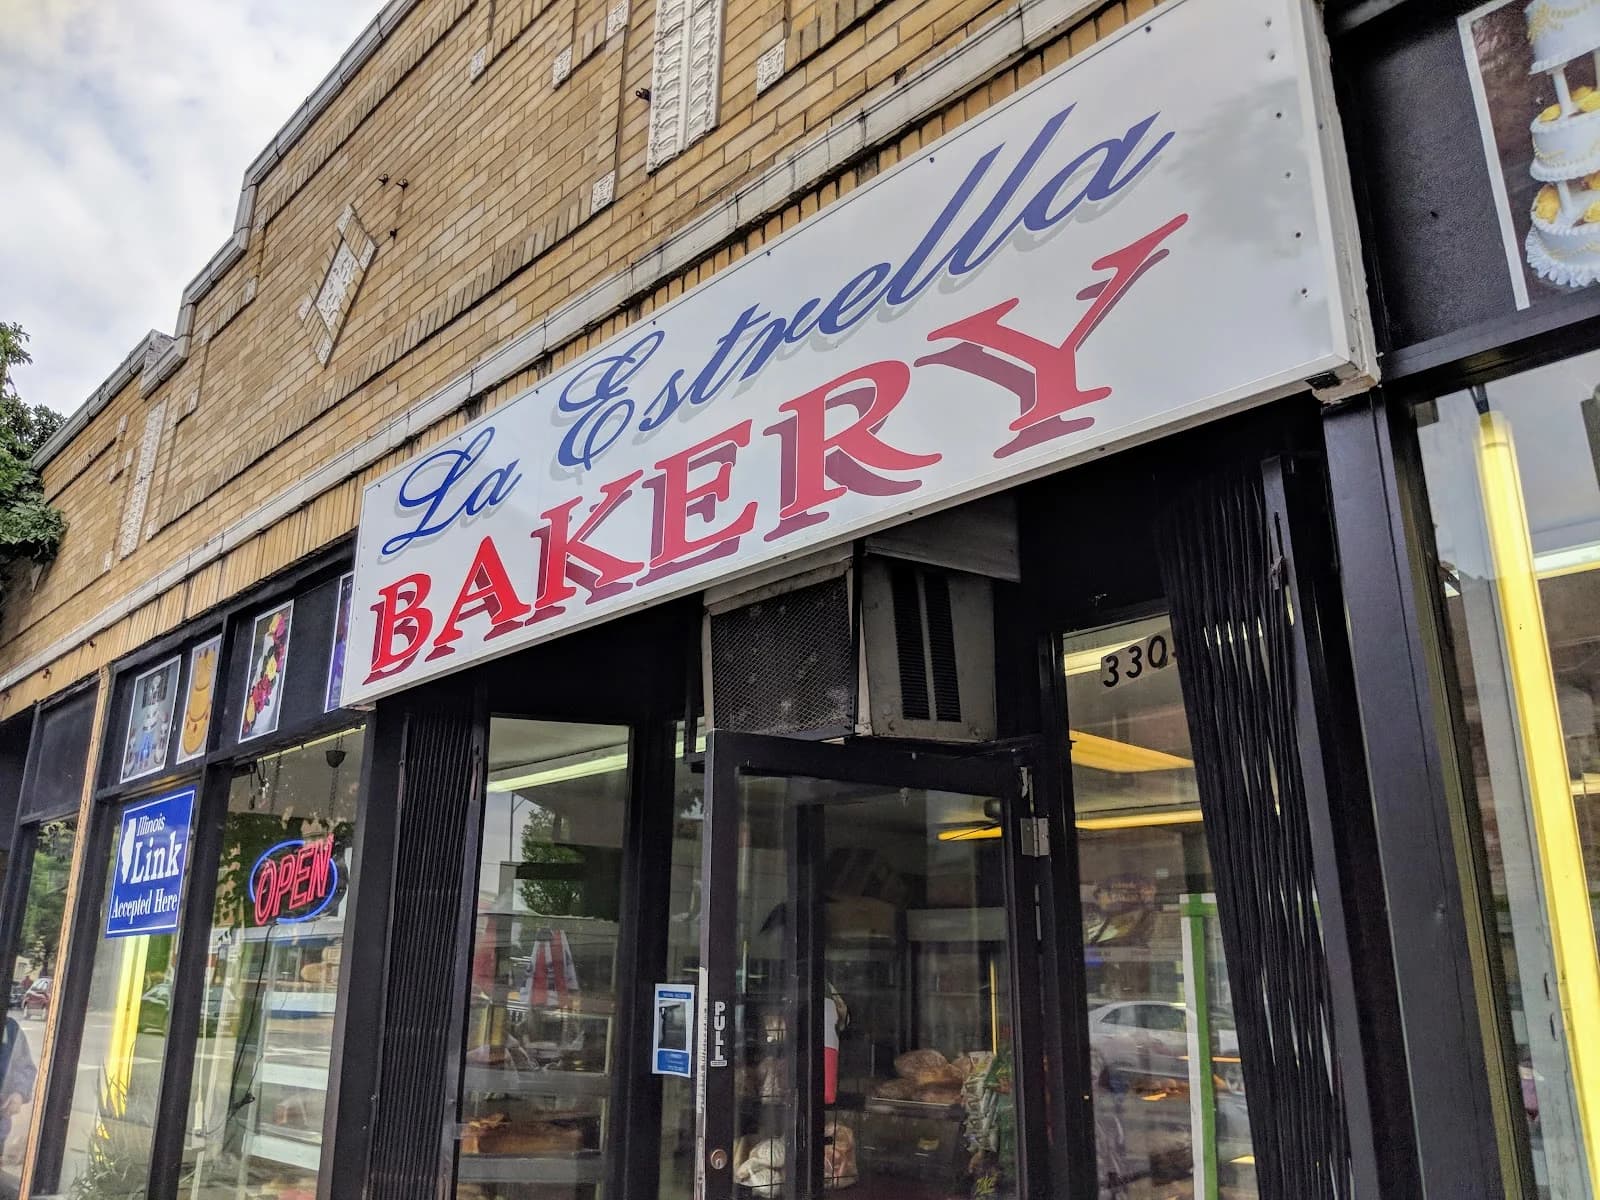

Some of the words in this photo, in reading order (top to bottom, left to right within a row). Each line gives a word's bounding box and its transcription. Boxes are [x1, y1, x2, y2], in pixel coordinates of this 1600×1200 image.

[381, 426, 522, 556] La
[556, 101, 1176, 471] Estrella
[363, 213, 1189, 685] BAKERY
[1103, 634, 1178, 688] 330
[136, 812, 166, 837] Illinois
[130, 830, 182, 885] Link
[254, 832, 335, 926] OPEN
[111, 889, 151, 925] Accepted
[154, 887, 178, 914] Here
[713, 1001, 726, 1061] PULL
